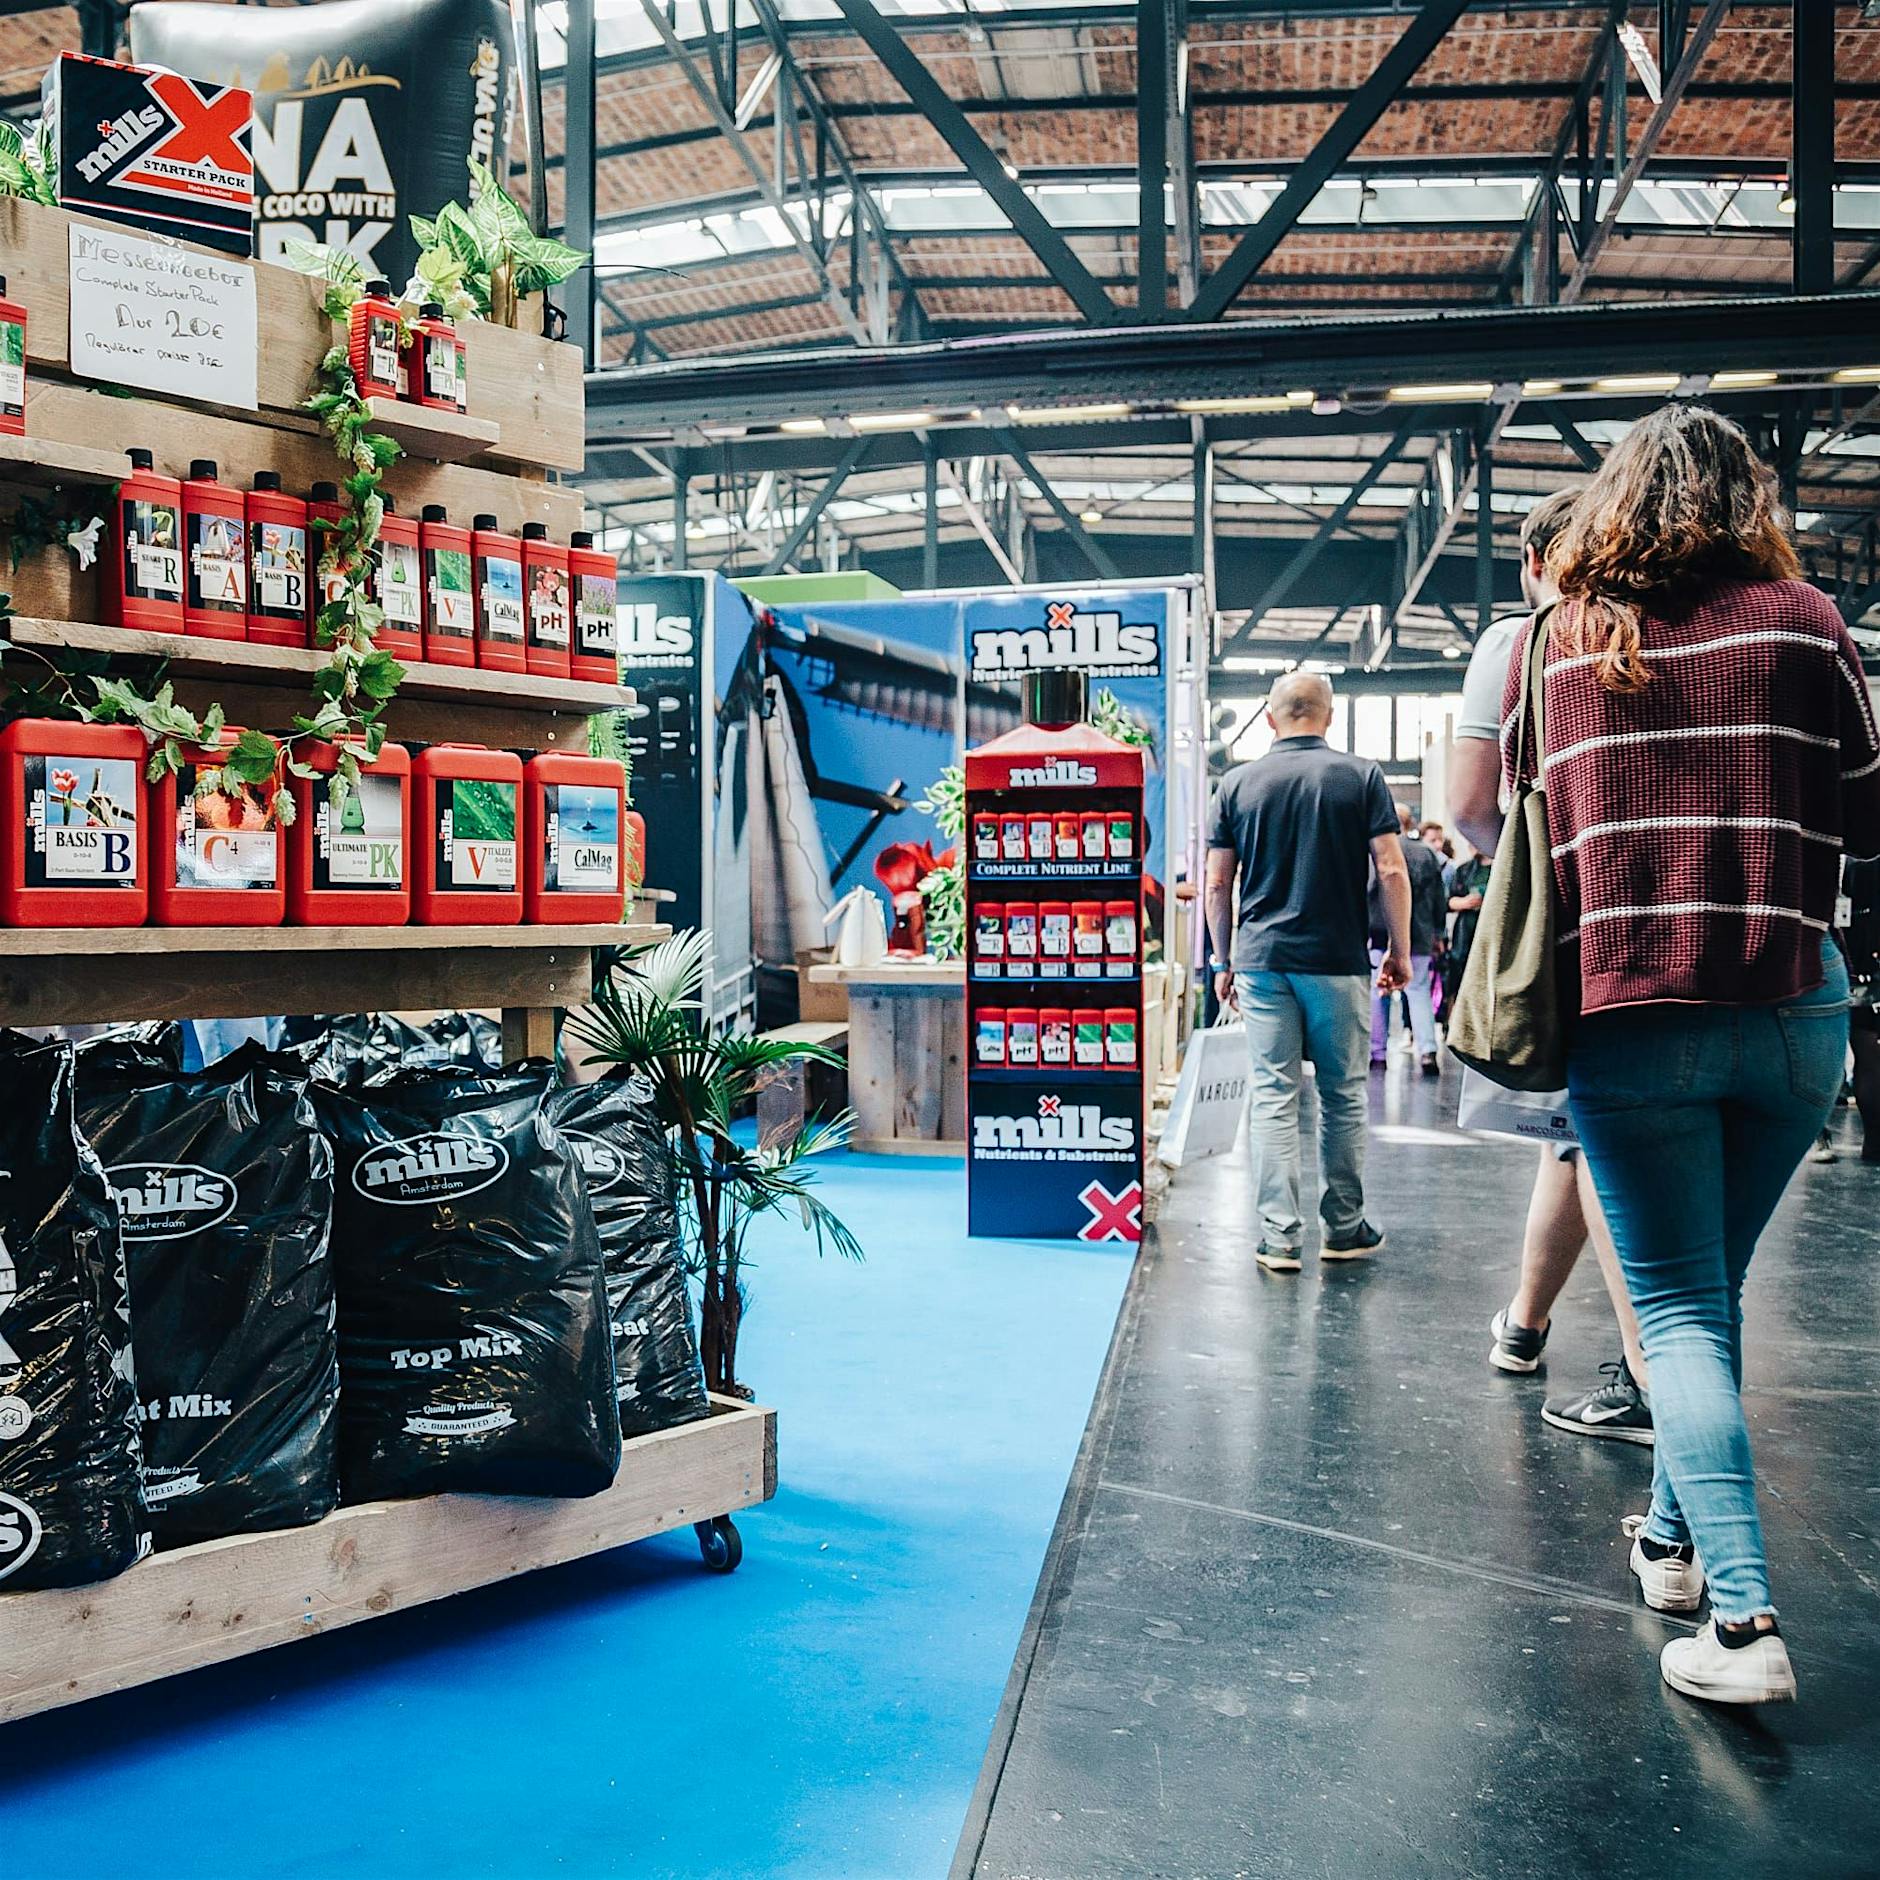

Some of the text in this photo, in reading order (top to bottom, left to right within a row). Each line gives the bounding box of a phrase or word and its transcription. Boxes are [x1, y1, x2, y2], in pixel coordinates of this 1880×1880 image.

[75, 104, 165, 184] mills
[144, 160, 246, 188] STARTER PACK
[262, 194, 327, 218] COCO
[327, 193, 396, 218] WITH
[76, 267, 140, 293] Complete
[165, 309, 225, 340] 20€
[163, 557, 178, 585] R
[221, 567, 242, 600] A
[264, 571, 283, 581] BASIS
[284, 574, 301, 606] B
[401, 591, 417, 617] PK
[973, 602, 1158, 667] mills
[1009, 756, 1098, 788] mills
[25, 788, 46, 853] mills
[313, 801, 330, 860] mills
[438, 808, 453, 862] mills
[55, 831, 132, 873] BASIS B
[331, 843, 400, 878] ULTIMATE PK
[574, 848, 613, 874] CalMag
[973, 1094, 1135, 1150] mills
[365, 1139, 497, 1187] mills
[973, 1148, 1137, 1162] Nutrients & Substrates
[400, 1177, 464, 1196] Amsterdam
[119, 1216, 187, 1232] Amsterdam
[611, 1317, 650, 1337] eat
[390, 1334, 524, 1370] Top Mix
[168, 1394, 232, 1419] Mix
[422, 1400, 496, 1415] Quality Products
[430, 1419, 490, 1432] GUARANTEED
